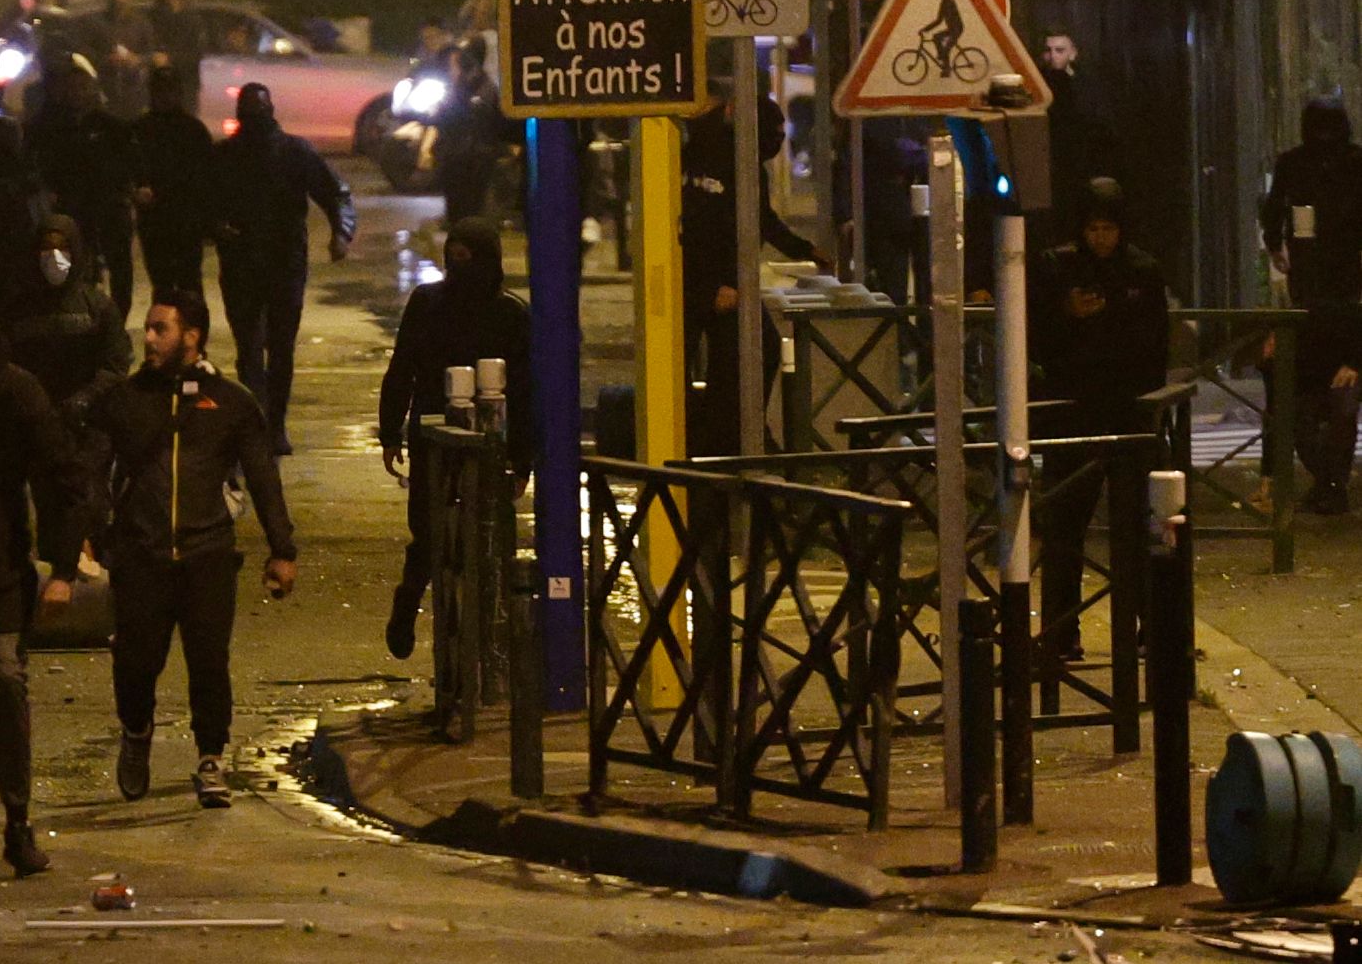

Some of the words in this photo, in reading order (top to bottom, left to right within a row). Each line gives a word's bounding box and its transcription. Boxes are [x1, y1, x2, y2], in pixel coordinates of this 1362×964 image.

[556, 9, 576, 50] à
[588, 18, 646, 49] nos
[522, 54, 662, 98] Enfants
